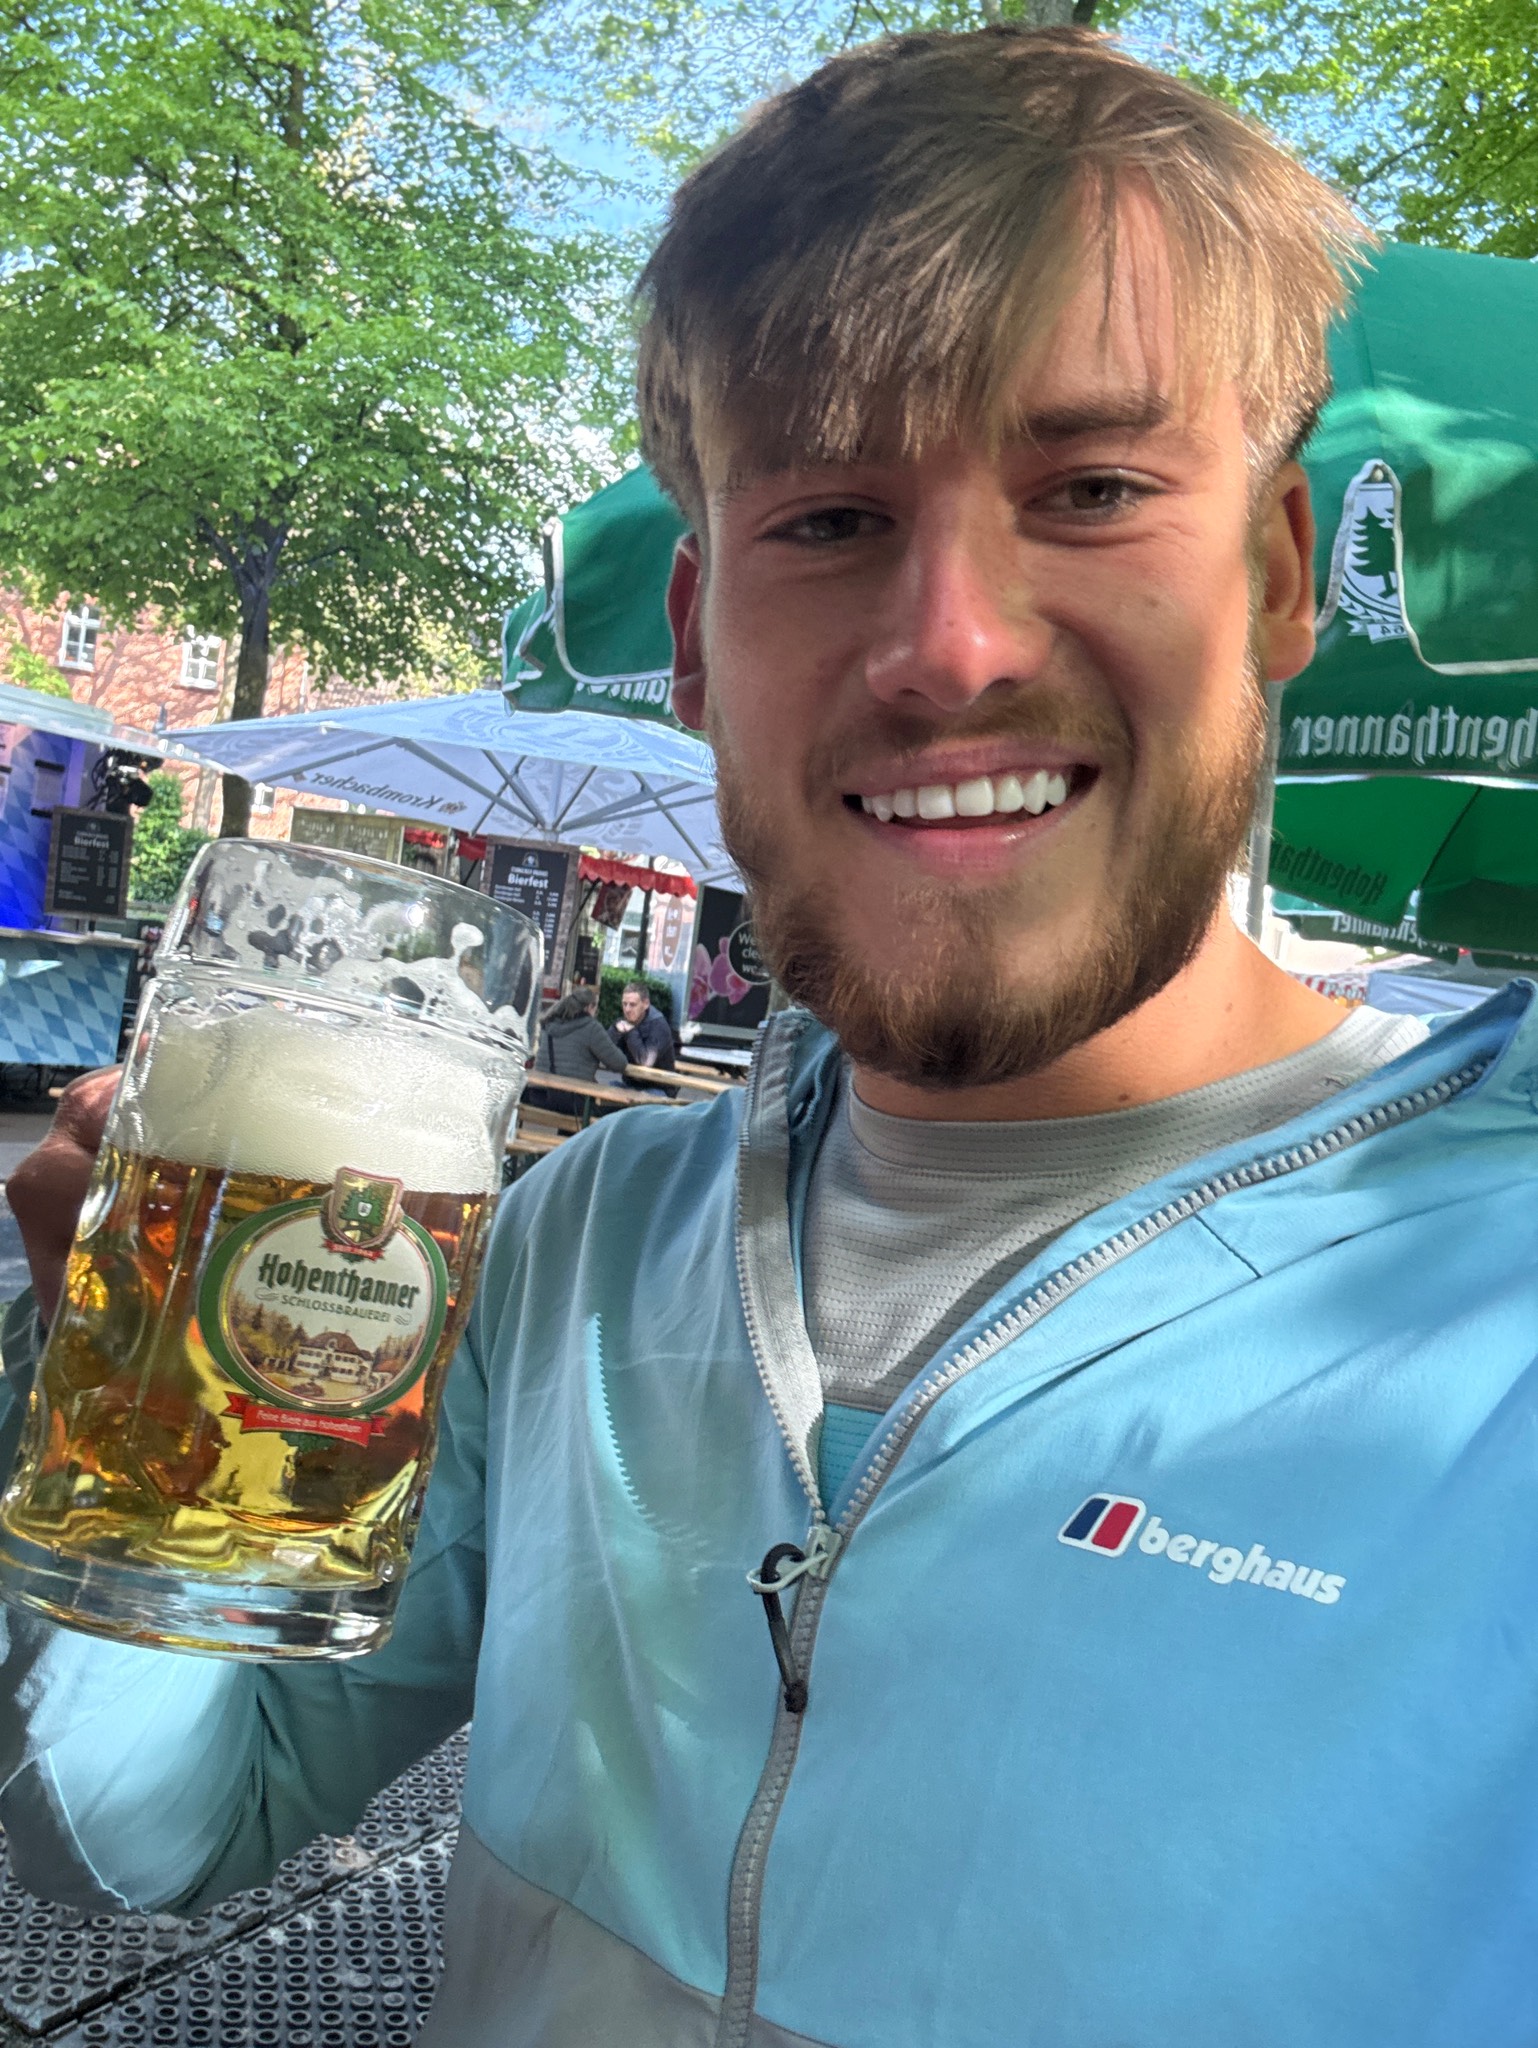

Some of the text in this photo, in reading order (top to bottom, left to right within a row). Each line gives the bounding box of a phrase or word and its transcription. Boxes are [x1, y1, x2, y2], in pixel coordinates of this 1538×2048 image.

[507, 872, 549, 889] Bierfest
[258, 1252, 420, 1309] Hohenthanner
[281, 1294, 391, 1323] SCHLOSSBRAUEREI
[1138, 1515, 1347, 1605] berghaus
